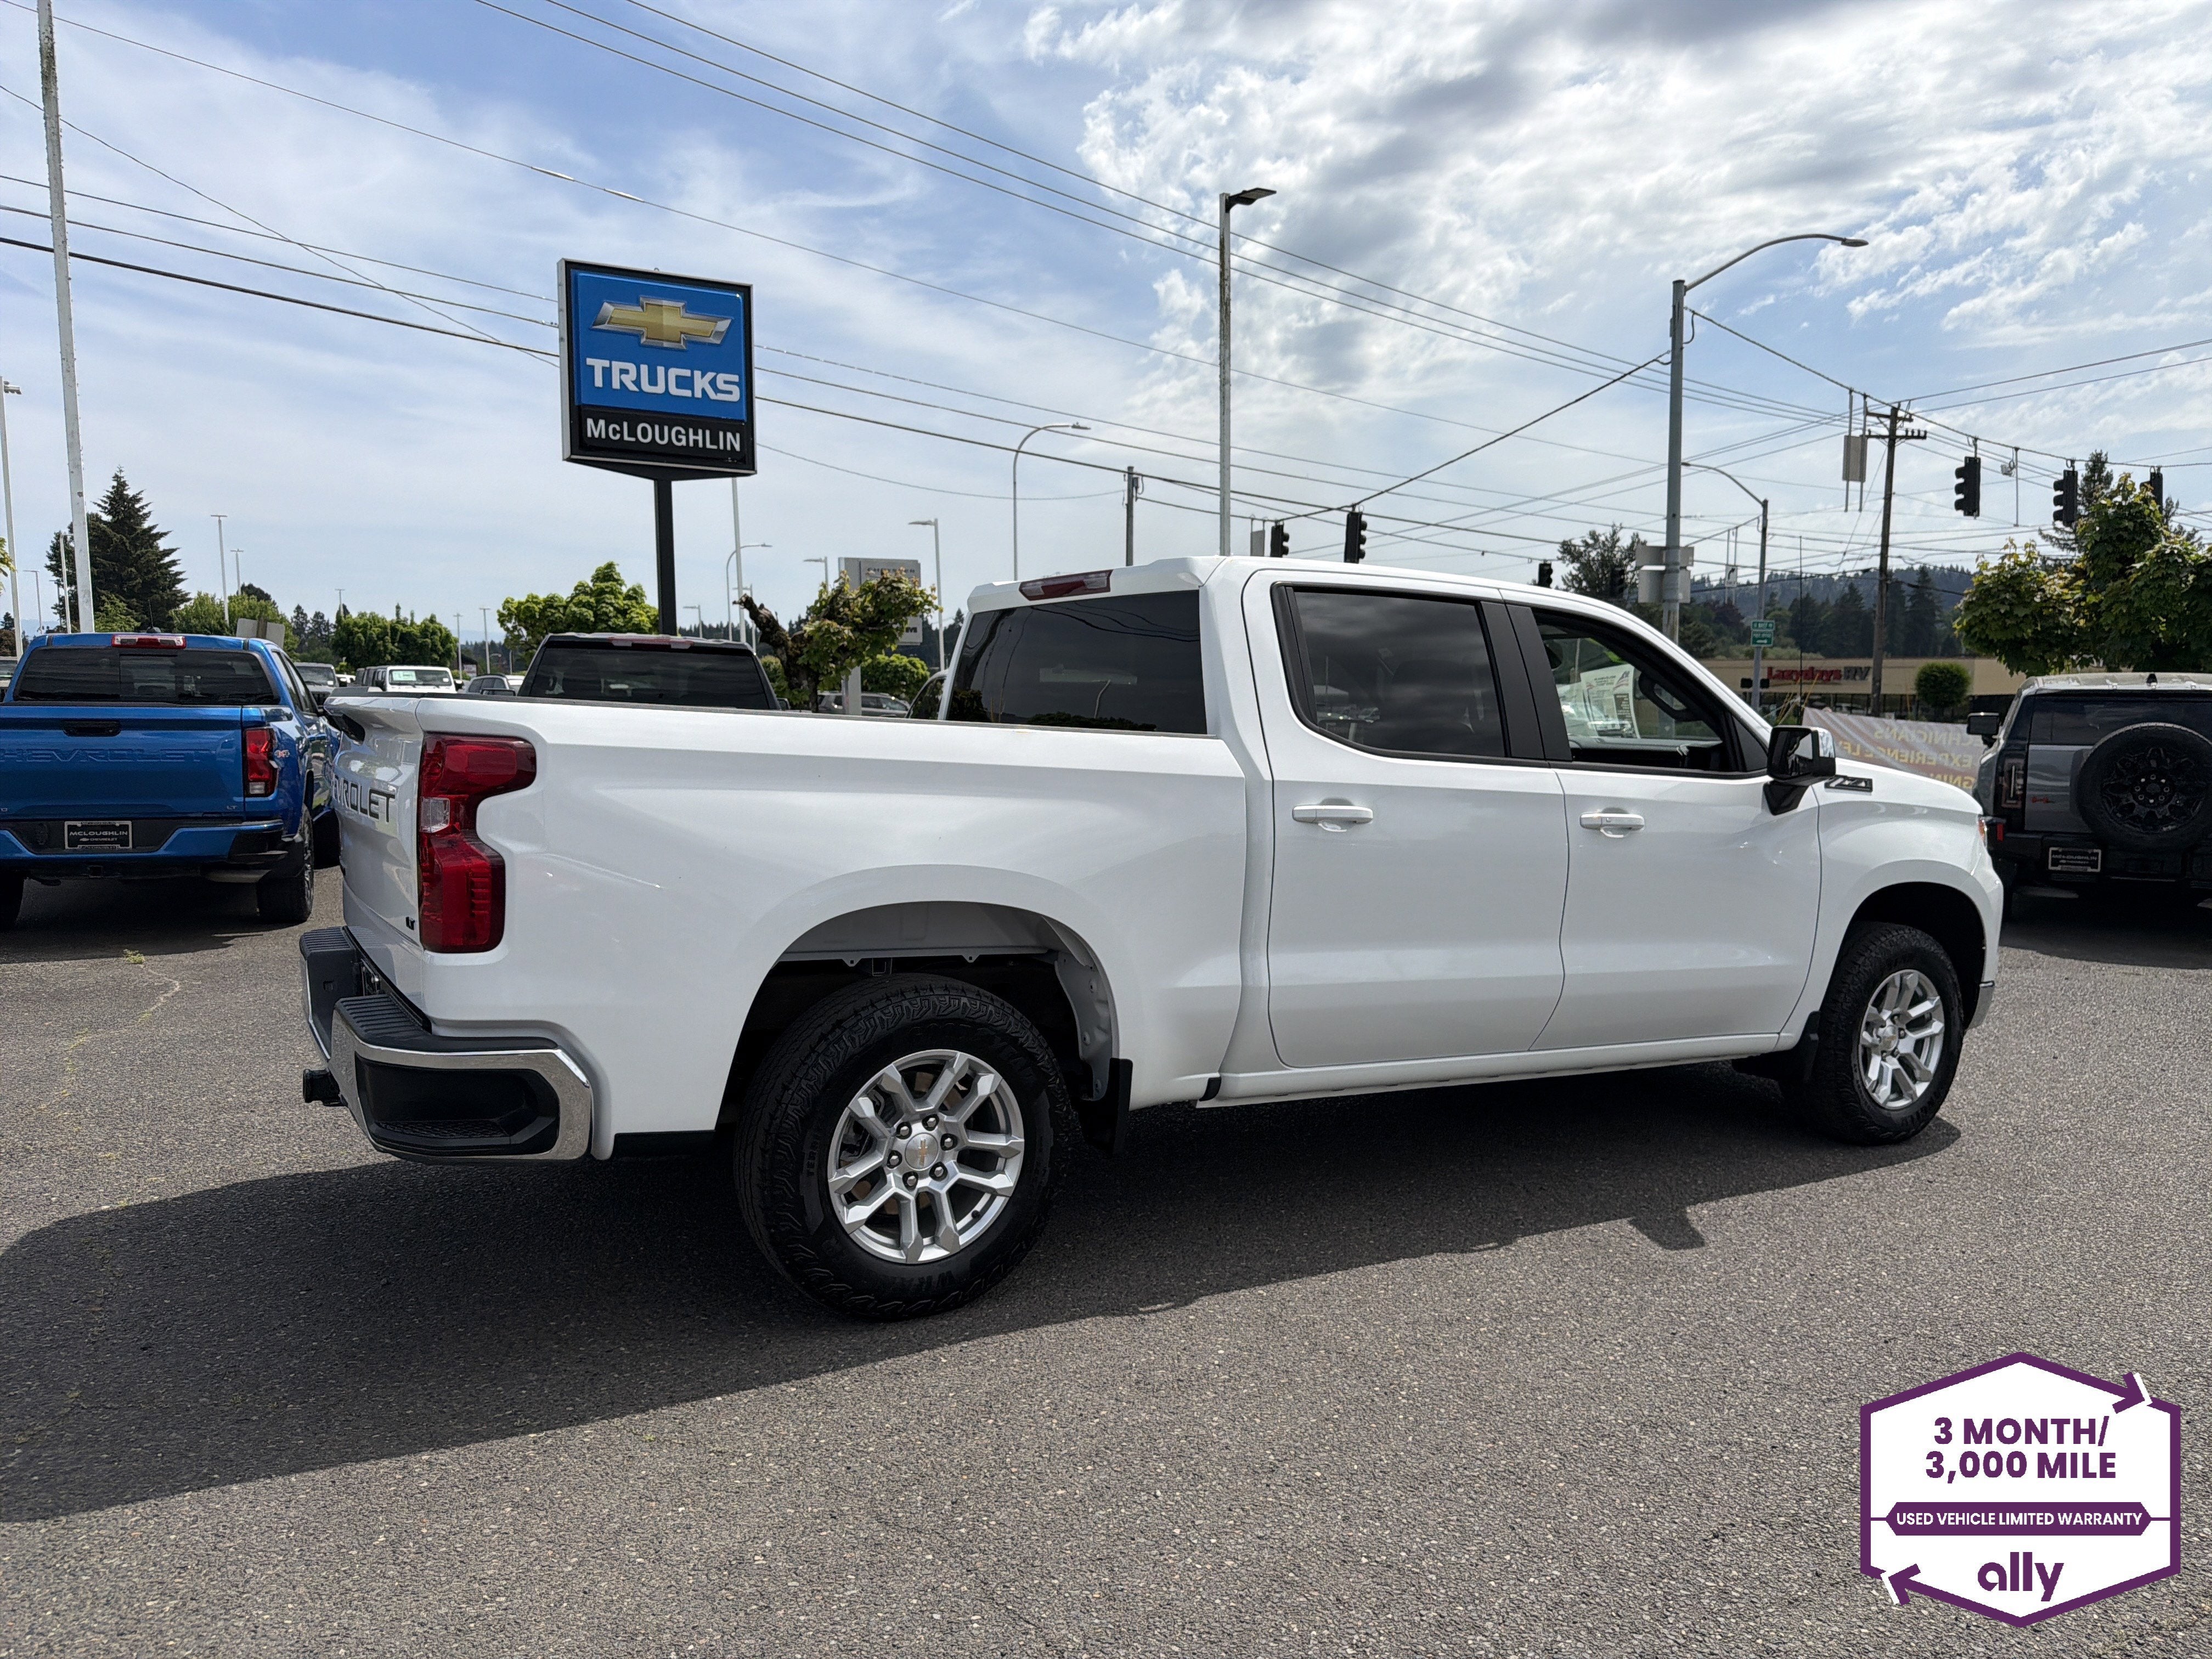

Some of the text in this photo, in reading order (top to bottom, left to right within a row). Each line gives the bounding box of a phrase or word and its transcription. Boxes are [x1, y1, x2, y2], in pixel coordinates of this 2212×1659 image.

[586, 357, 740, 402] TRUCKS
[586, 417, 741, 452] McLOUGHLIN
[1843, 667, 1871, 680] RV
[0, 748, 210, 762] HEVROLET
[331, 772, 396, 823] EVROLET
[405, 916, 415, 930] LT
